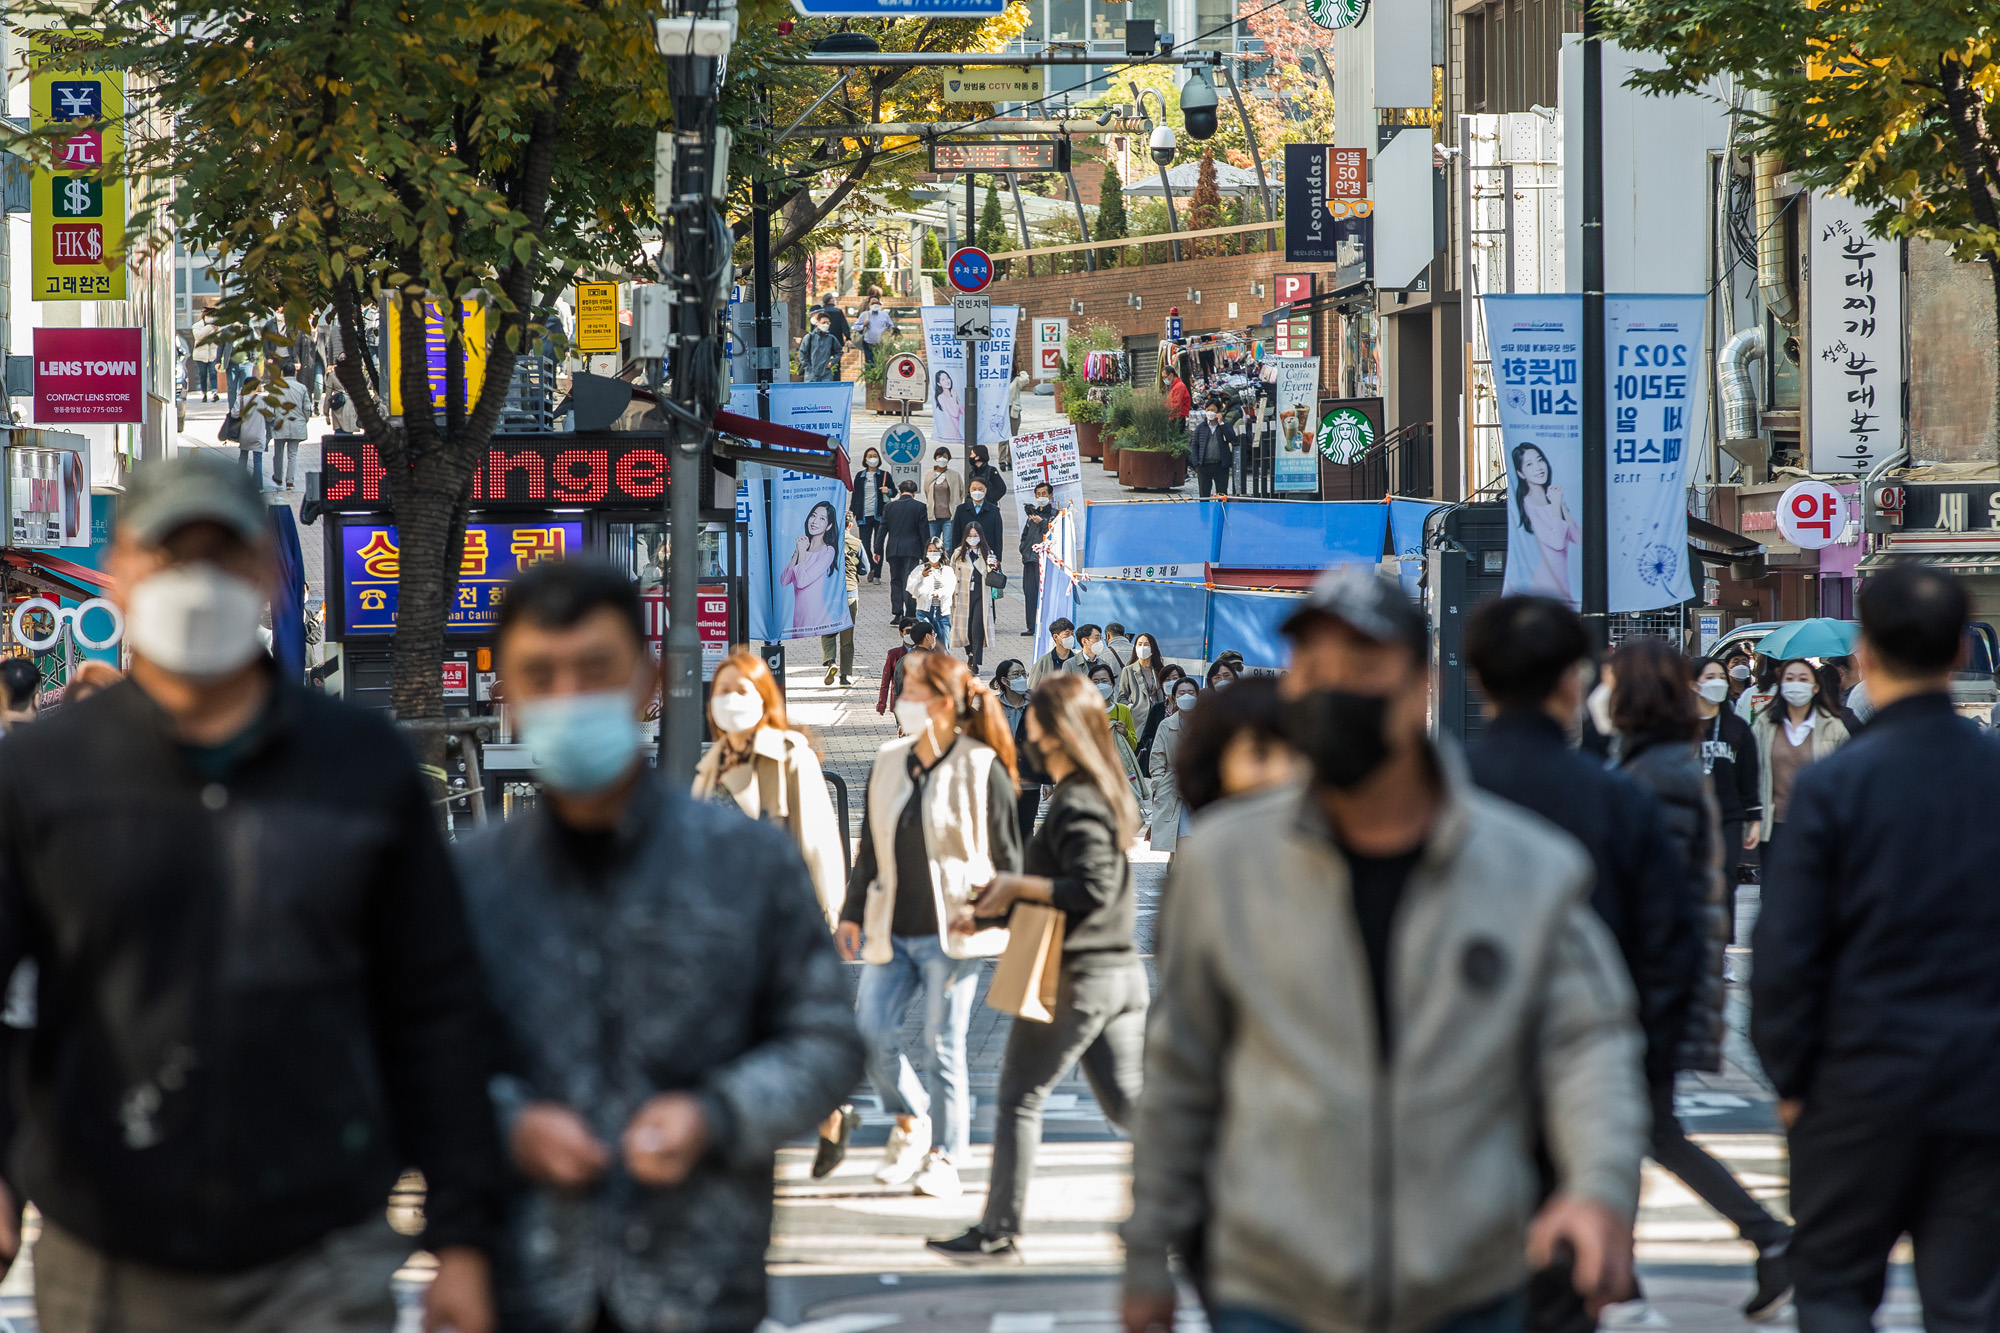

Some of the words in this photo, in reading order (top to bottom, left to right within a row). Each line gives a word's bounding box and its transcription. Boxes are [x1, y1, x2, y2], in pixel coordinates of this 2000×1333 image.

[963, 82, 986, 91] 방범용
[988, 82, 1012, 90] CCTV
[1013, 82, 1029, 91] 작동
[1031, 82, 1039, 91] 중
[1335, 151, 1361, 166] 으뜸
[1338, 167, 1358, 180] 50
[1335, 181, 1361, 195] 안경
[64, 179, 91, 215] $
[1306, 154, 1322, 242] Leonidas
[55, 228, 102, 261] HK$
[954, 266, 988, 274] 주차금지
[46, 276, 111, 294] 고래환전
[1286, 277, 1300, 298] P
[1417, 280, 1426, 289] B1
[1841, 235, 1877, 338] 부대찌개
[957, 300, 989, 308] 견인지역
[40, 361, 83, 376] LENS
[83, 361, 136, 376] TOWN
[1281, 361, 1317, 369] Leonidas
[1286, 369, 1310, 382] Coffee
[1282, 381, 1313, 392] Event
[46, 393, 84, 402] CONTACT
[84, 393, 104, 402] LENS
[105, 393, 130, 402] STORE
[1837, 352, 1881, 470] 부대볶음
[1016, 448, 1043, 460] Verichip
[1045, 444, 1058, 454] 666
[1059, 441, 1073, 452] Hell
[895, 466, 918, 474] 구간내
[1017, 469, 1027, 477] Lord
[1021, 474, 1038, 482] Heaven
[1876, 487, 1905, 525] 약
[1791, 492, 1837, 539] 약
[1122, 567, 1142, 578] 안전
[1158, 565, 1179, 576] 제일
[707, 603, 724, 611] LTE
[468, 610, 499, 621] Callin
[1254, 668, 1275, 679] 안전
